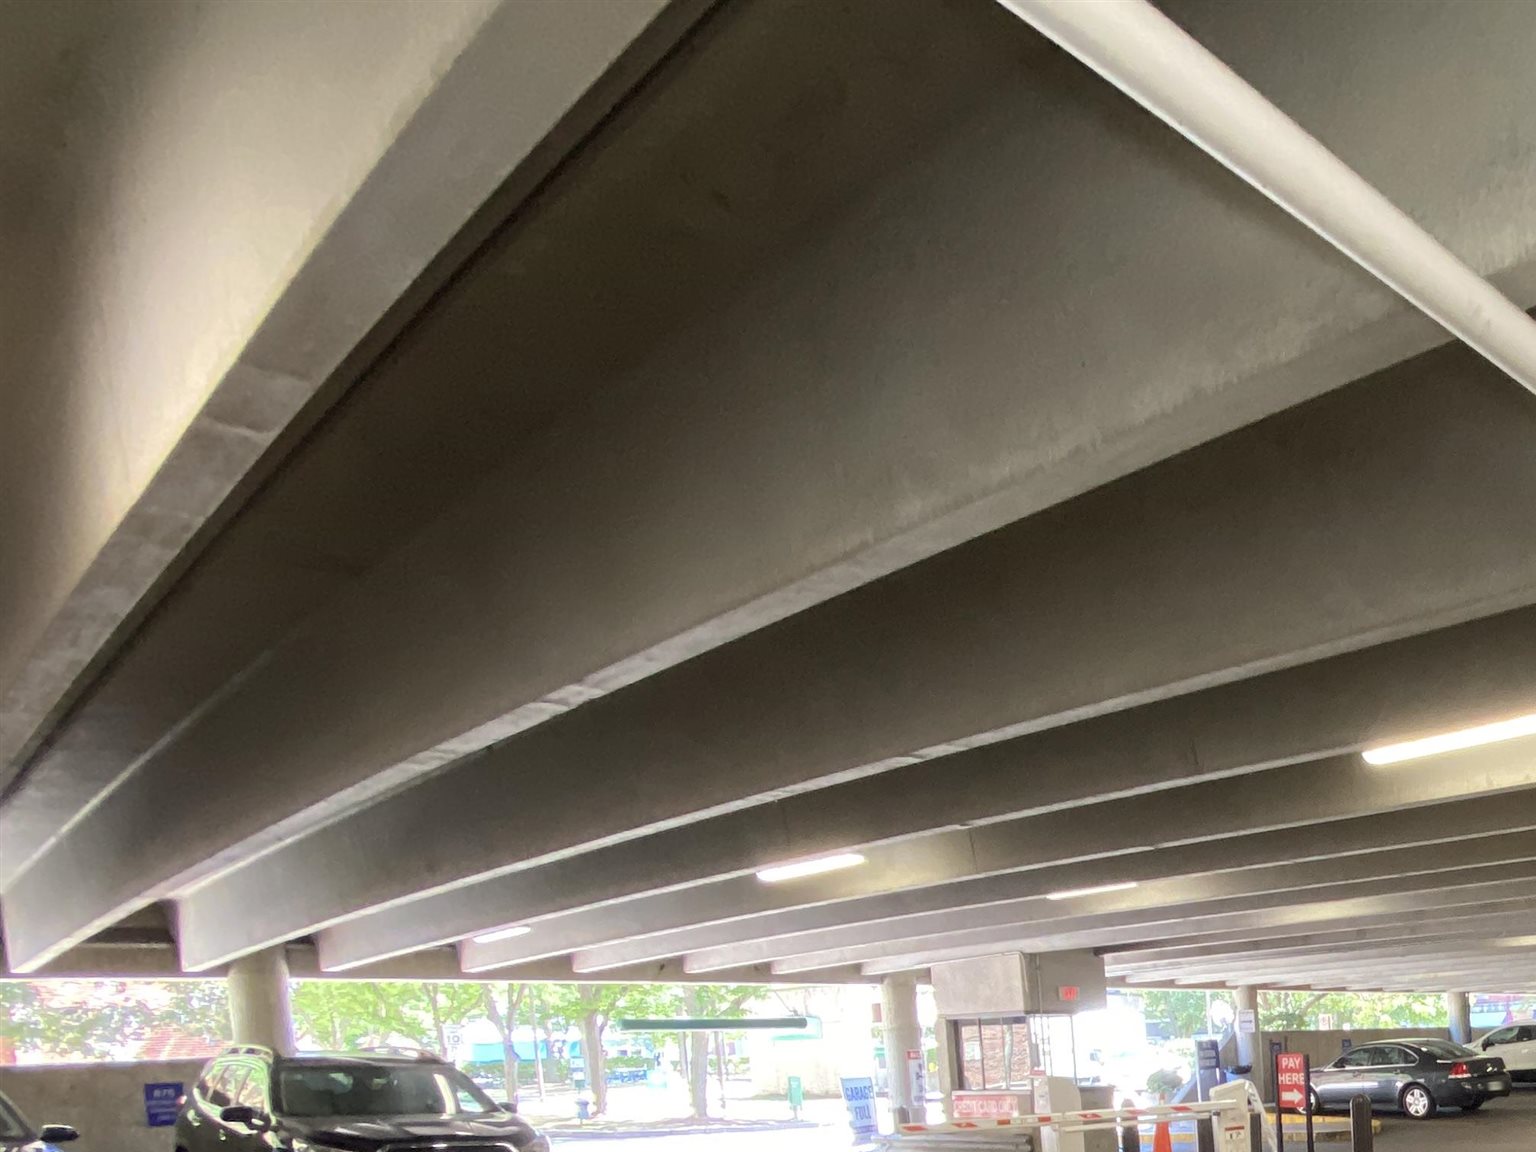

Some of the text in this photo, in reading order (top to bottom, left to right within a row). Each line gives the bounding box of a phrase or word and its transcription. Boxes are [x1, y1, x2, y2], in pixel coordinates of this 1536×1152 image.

[1282, 1057, 1301, 1069] PAY
[1278, 1072, 1305, 1085] HERE
[845, 1085, 873, 1101] GARAGE
[855, 1104, 872, 1120] FULL
